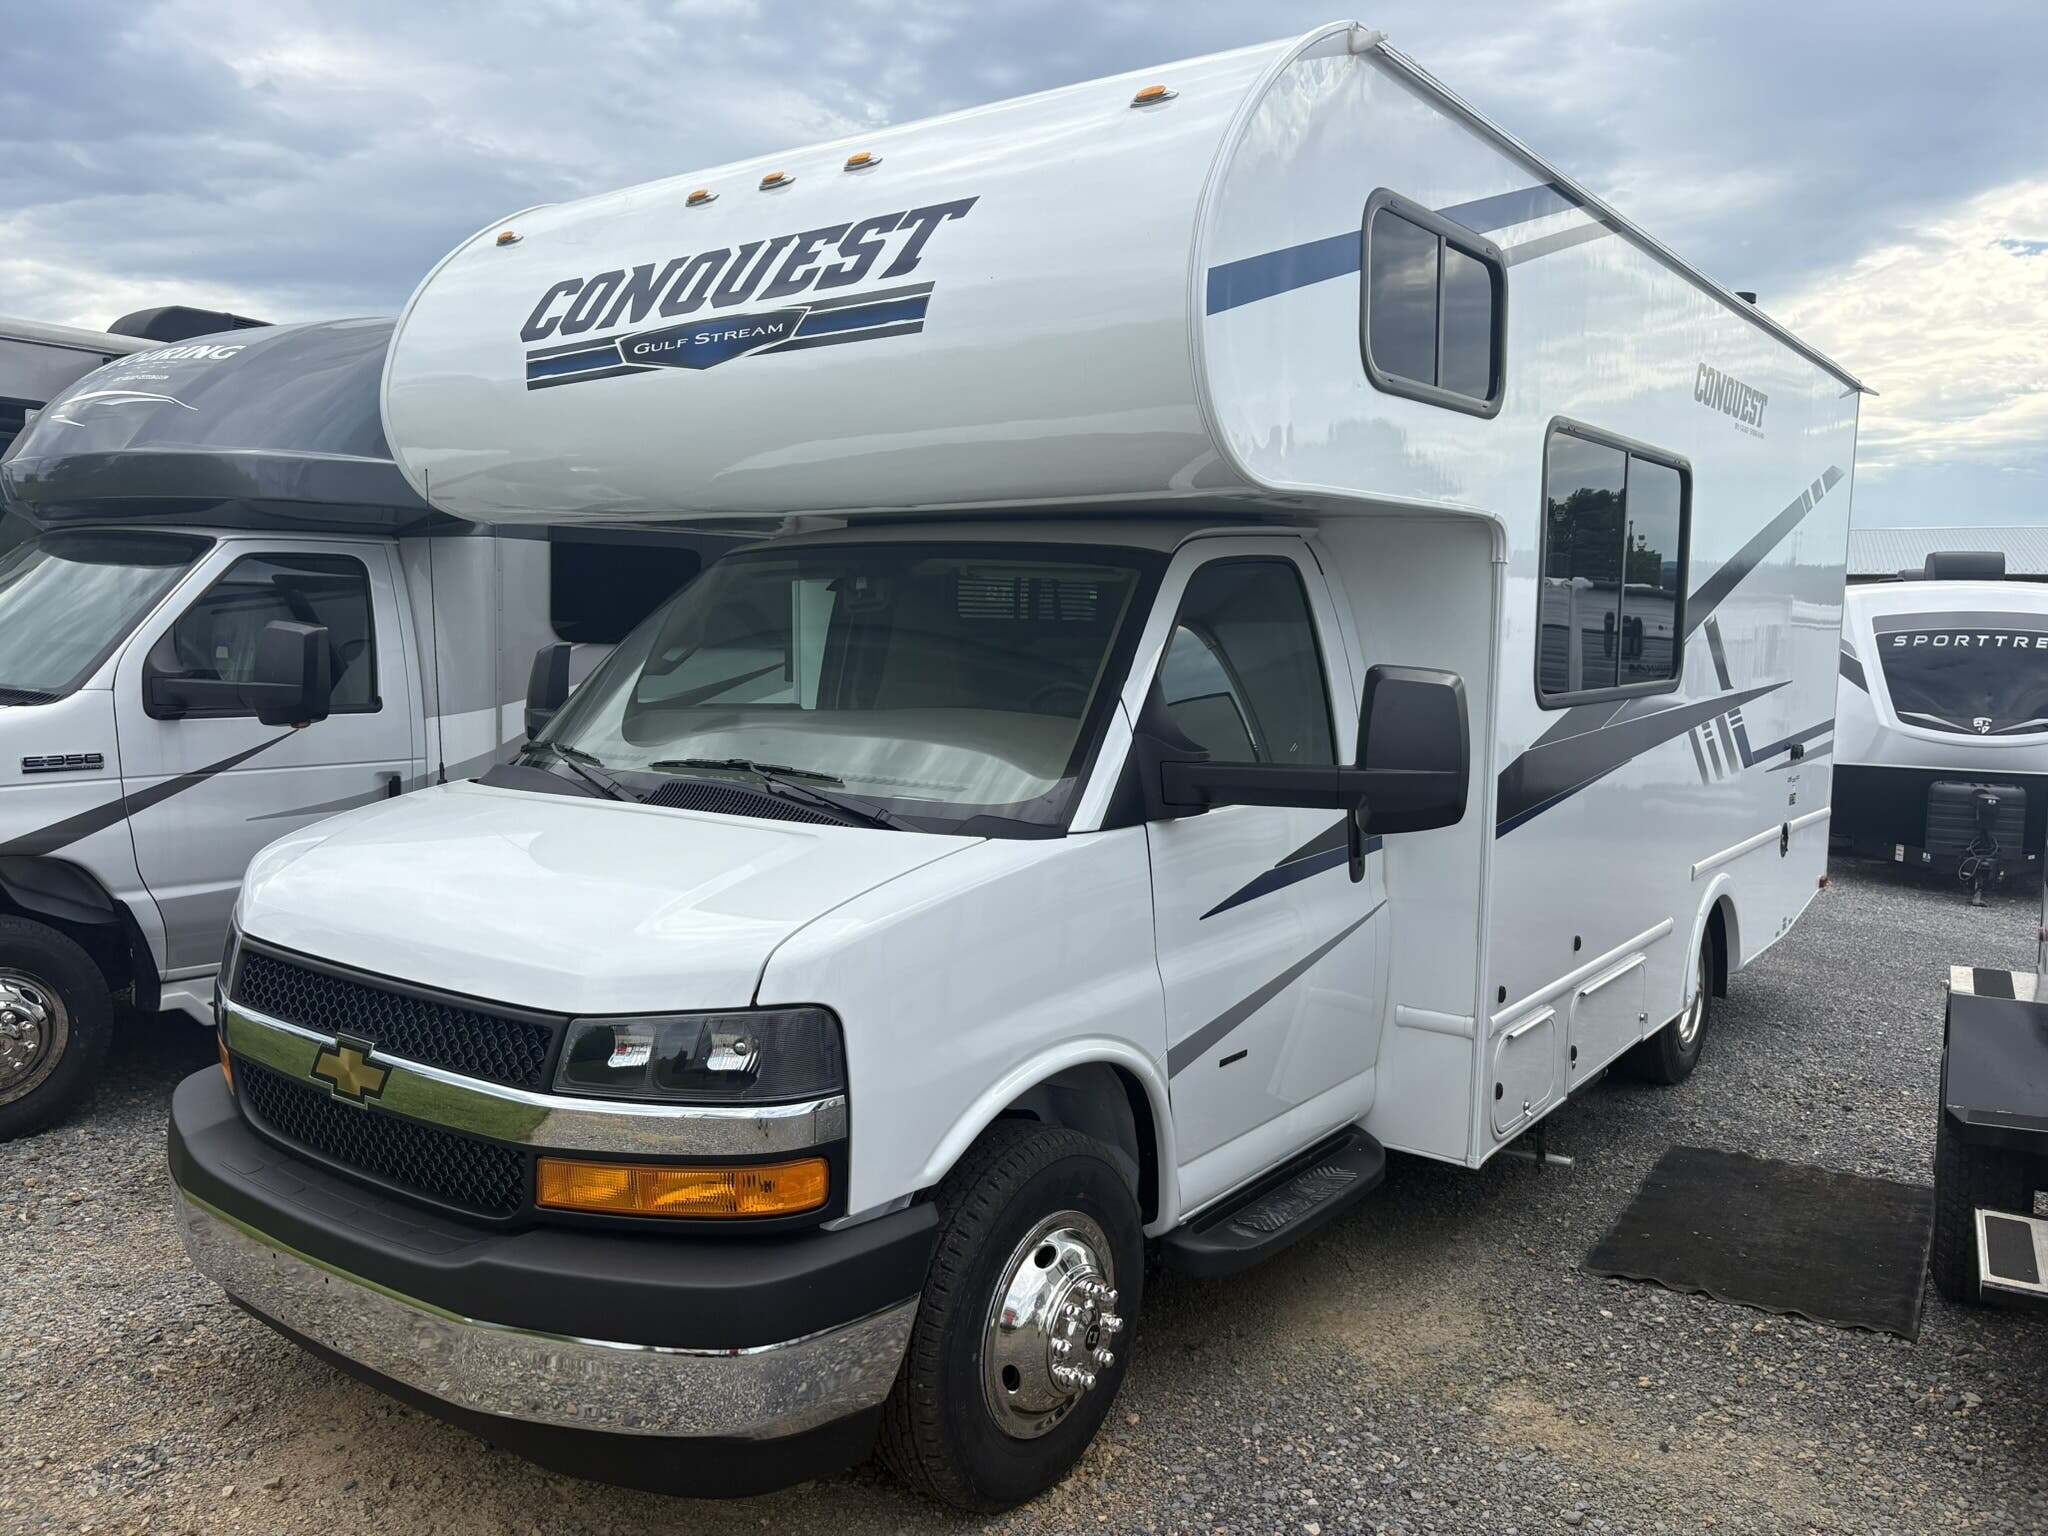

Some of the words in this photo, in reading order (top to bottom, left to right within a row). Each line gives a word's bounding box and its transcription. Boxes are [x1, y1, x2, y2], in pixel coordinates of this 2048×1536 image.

[519, 195, 981, 342] CONQUEST
[633, 338, 689, 354] GULF
[694, 322, 784, 345] STREAM
[1694, 362, 1769, 428] CONQUEST
[1893, 634, 2048, 649] SPORTTRE
